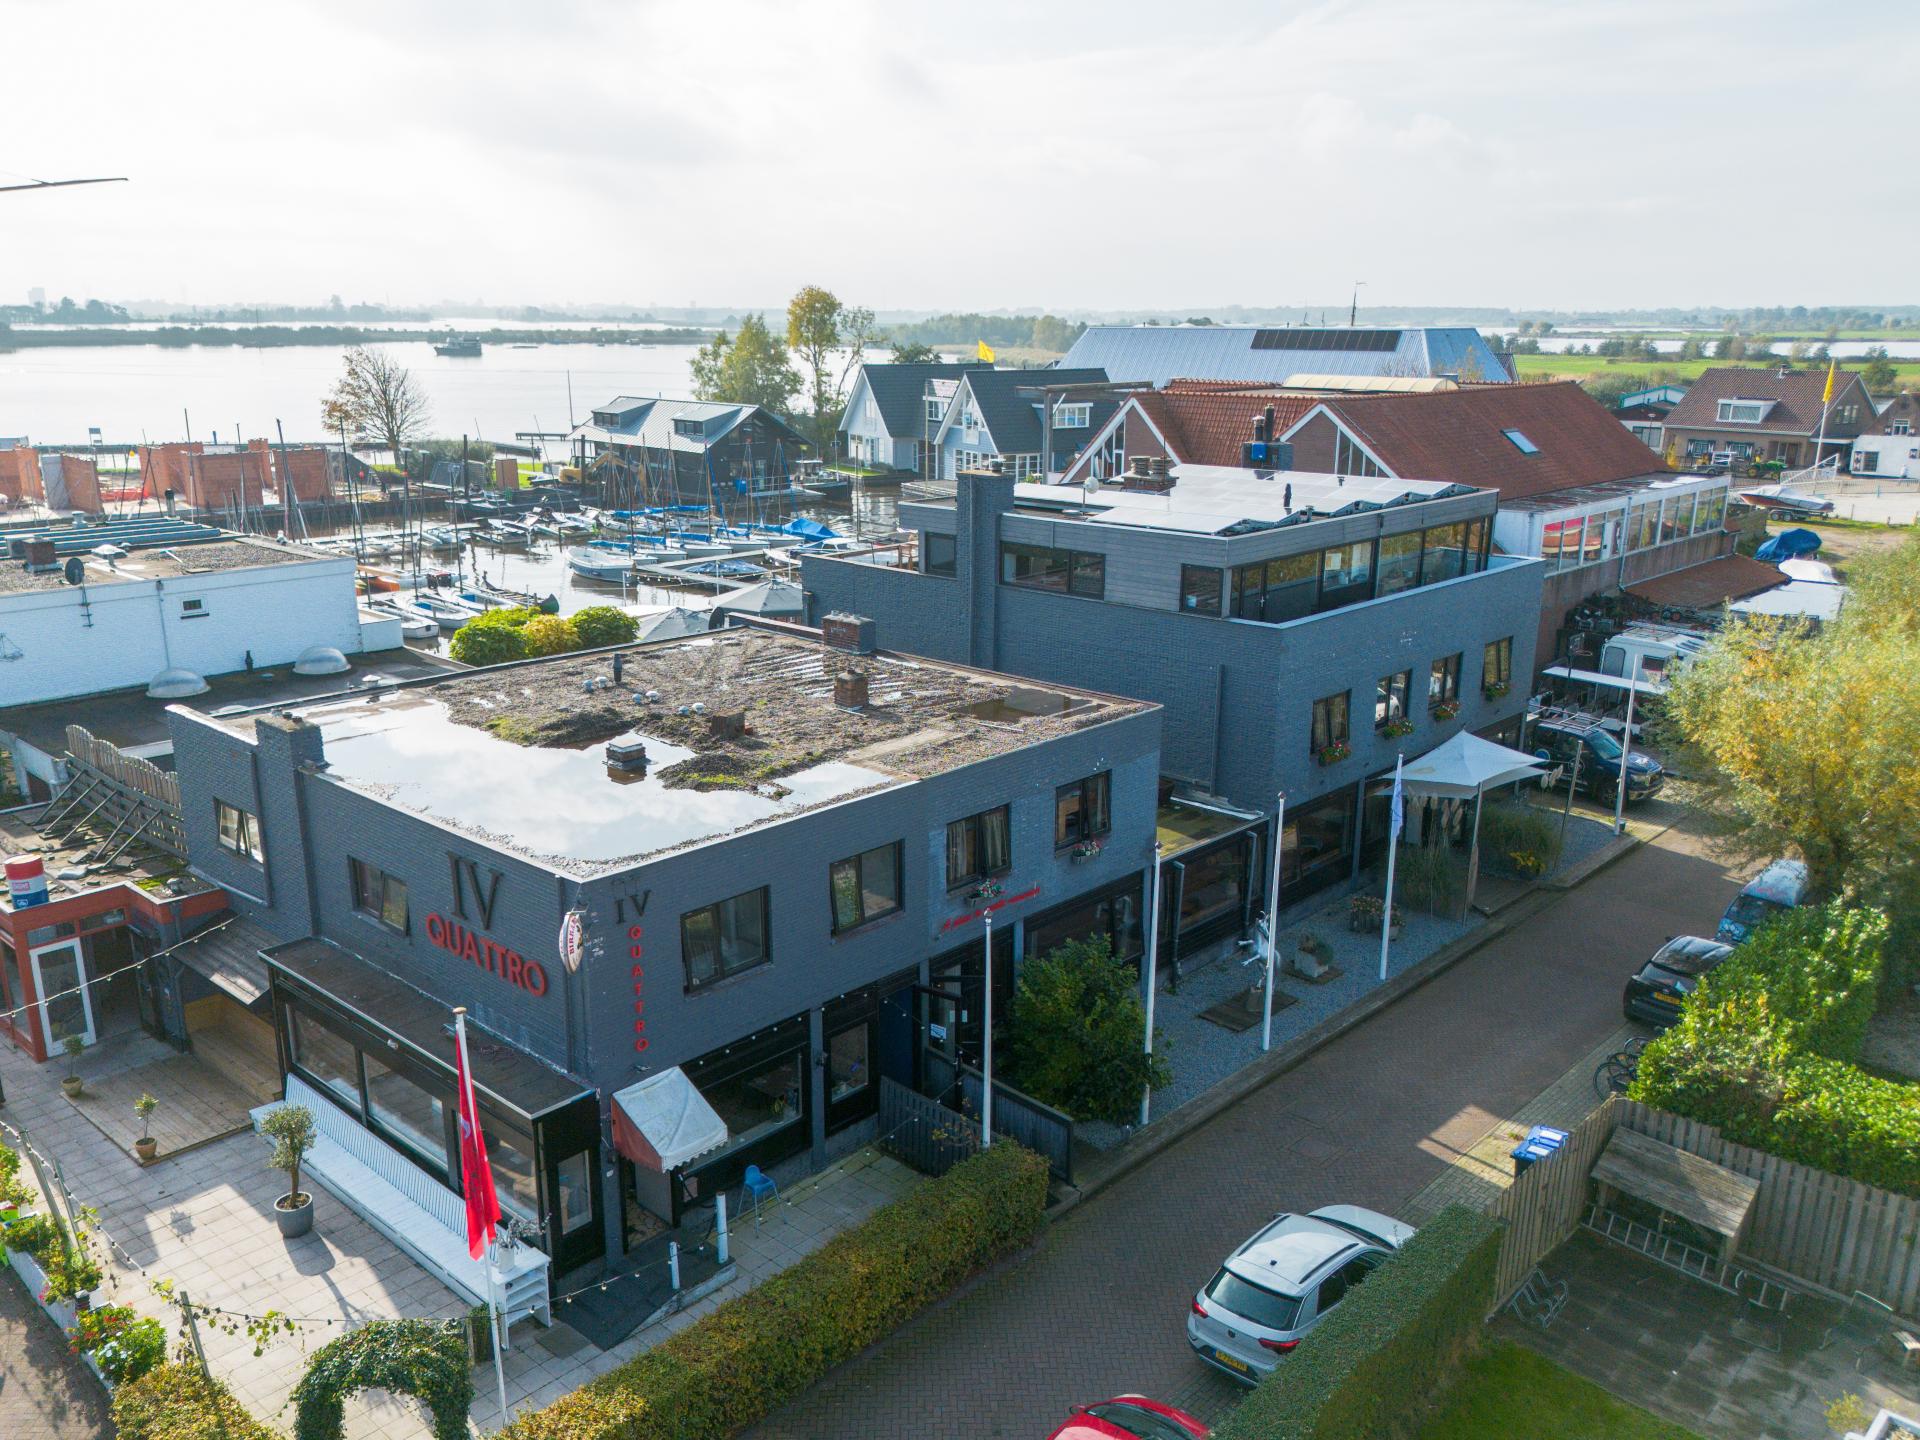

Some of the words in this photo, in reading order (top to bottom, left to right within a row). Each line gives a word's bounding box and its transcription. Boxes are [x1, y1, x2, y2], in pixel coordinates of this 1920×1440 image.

[447, 851, 503, 930] IV
[615, 889, 652, 924] IV
[425, 912, 548, 997] QUATTRO
[628, 925, 649, 1052] QUATTRO
